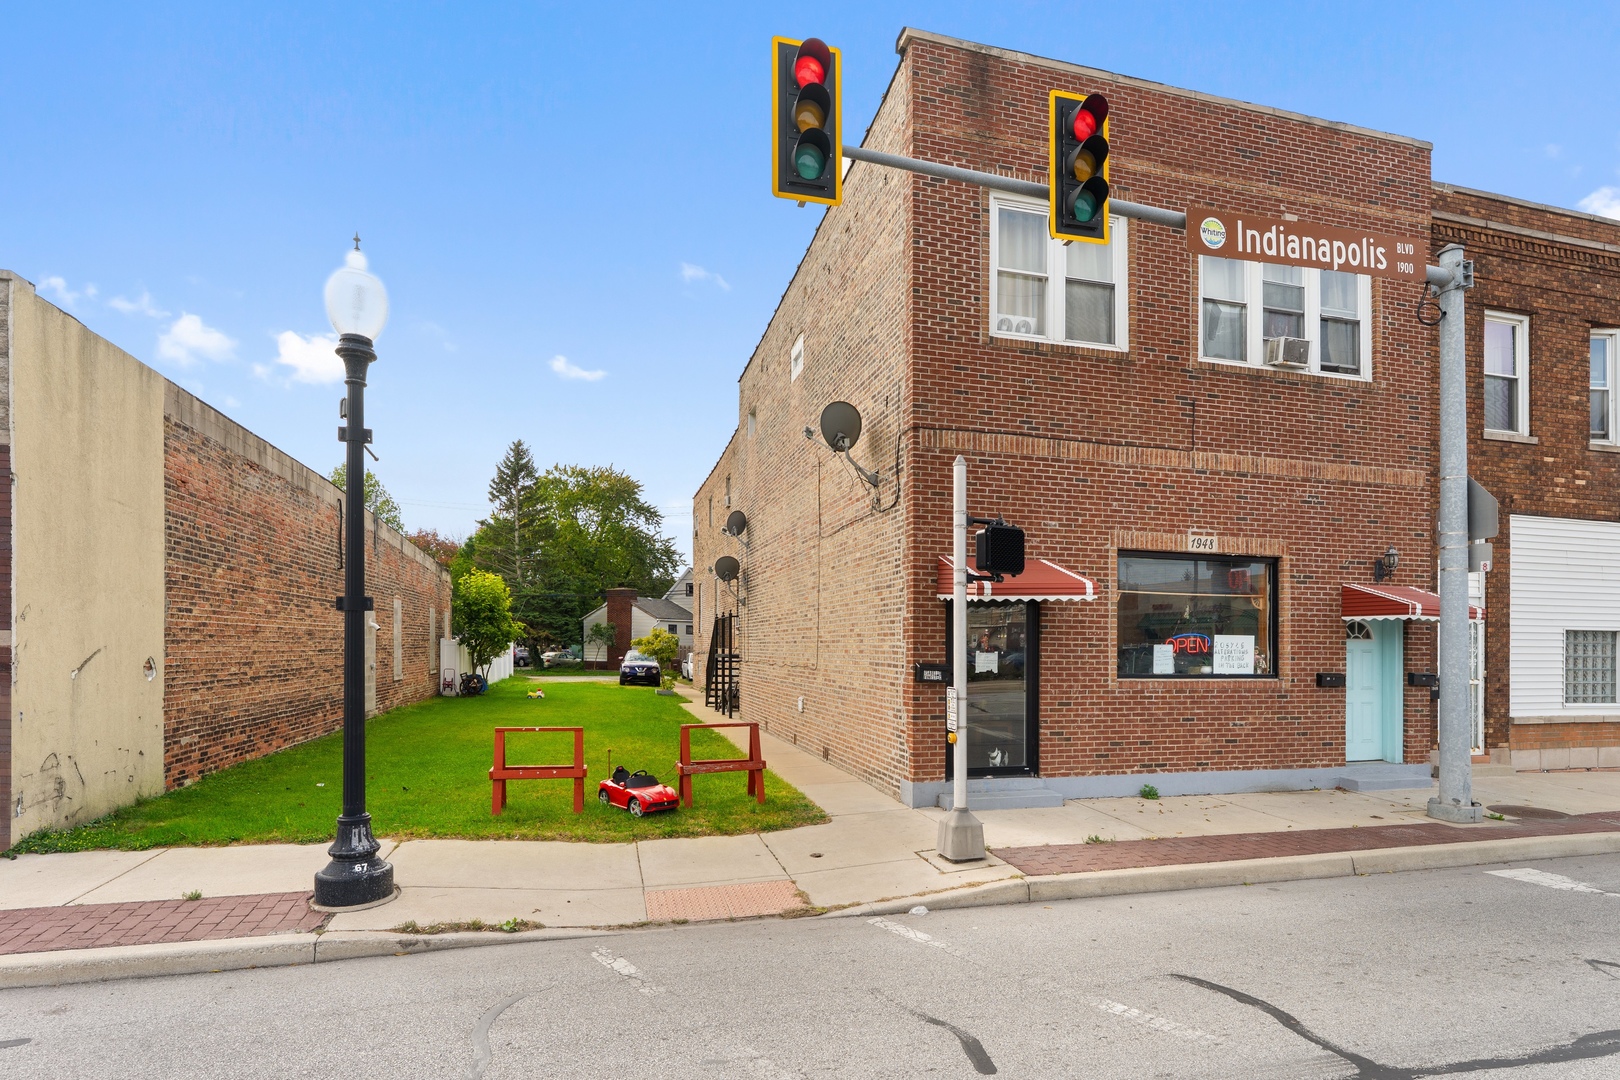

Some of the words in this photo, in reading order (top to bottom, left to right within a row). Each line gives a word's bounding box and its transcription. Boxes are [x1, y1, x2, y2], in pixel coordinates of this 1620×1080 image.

[1201, 227, 1225, 239] Whiting
[1237, 220, 1388, 271] Indianapolis
[1397, 242, 1414, 255] BLVD
[1397, 261, 1414, 274] 1900
[1190, 537, 1214, 550] 1948
[1165, 637, 1208, 653] OPEN
[354, 863, 368, 873] 67
